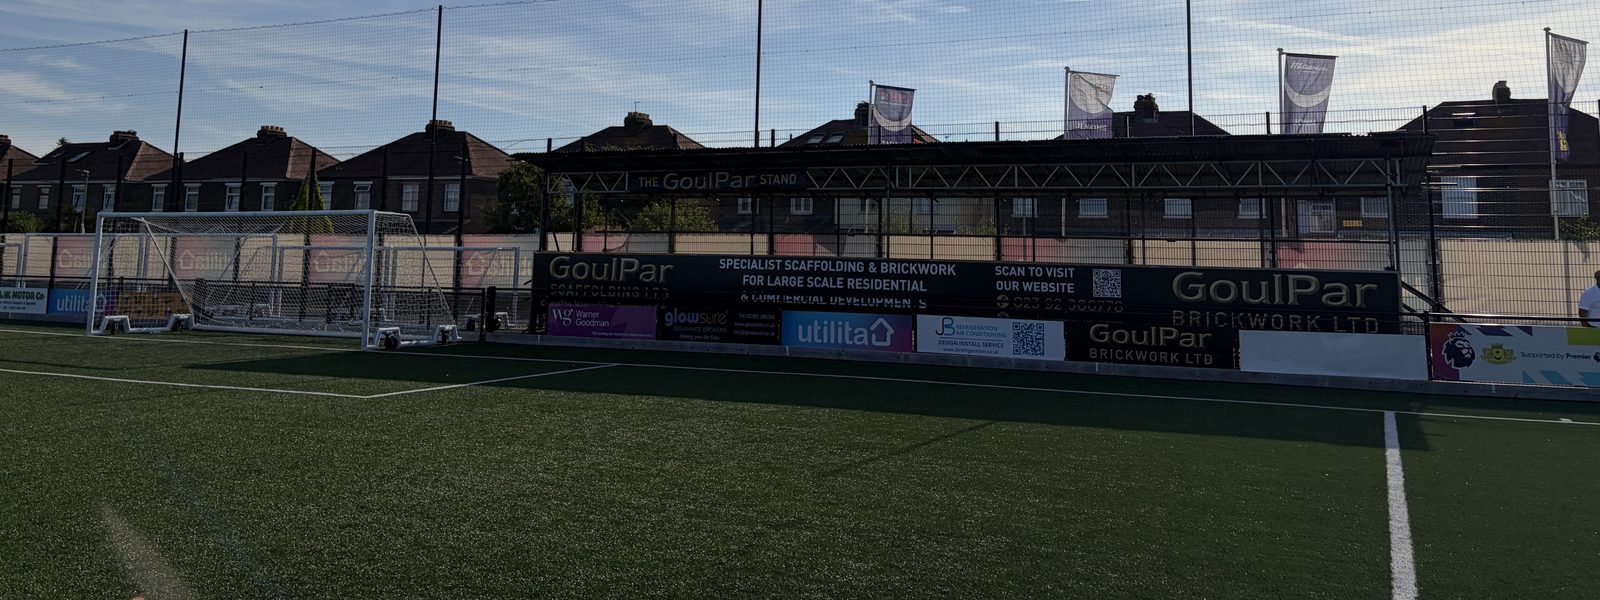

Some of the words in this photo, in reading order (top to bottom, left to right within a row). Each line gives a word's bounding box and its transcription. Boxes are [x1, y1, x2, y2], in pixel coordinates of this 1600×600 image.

[639, 177, 658, 188] THE
[663, 172, 755, 190] GoulPar
[760, 174, 797, 185] STAND
[550, 256, 674, 284] GoulPar
[719, 258, 782, 271] SPECIALIST
[785, 260, 864, 273] SCAFFOLDING
[868, 262, 877, 273] &
[881, 262, 957, 276] BRICKWORK
[995, 266, 1025, 276] SCAN
[1028, 266, 1043, 277] TO
[1046, 267, 1075, 278] VISIT
[742, 274, 764, 286] FOR
[767, 275, 804, 288] LARGE
[807, 277, 844, 289] SCALE
[847, 278, 927, 292] RESIDENTIAL
[996, 281, 1020, 291] OUR
[1022, 281, 1075, 294] WEBSITE
[1172, 271, 1378, 308] GoulPar
[12, 290, 35, 300] MOTOR
[576, 310, 600, 319] Warner
[576, 318, 610, 327] Goodman
[665, 307, 728, 326] glowsure
[1172, 310, 1321, 331] BRICKWORK
[1334, 315, 1379, 334] LTD
[799, 319, 869, 346] utilita
[956, 324, 998, 332] REFRIGERATION
[1089, 323, 1212, 349] GoulPar
[1089, 348, 1180, 363] BRICKWORK
[1186, 353, 1213, 365] LTD
[1521, 351, 1555, 359] Supported
[1556, 352, 1565, 360] by
[1566, 352, 1591, 360] Premier
